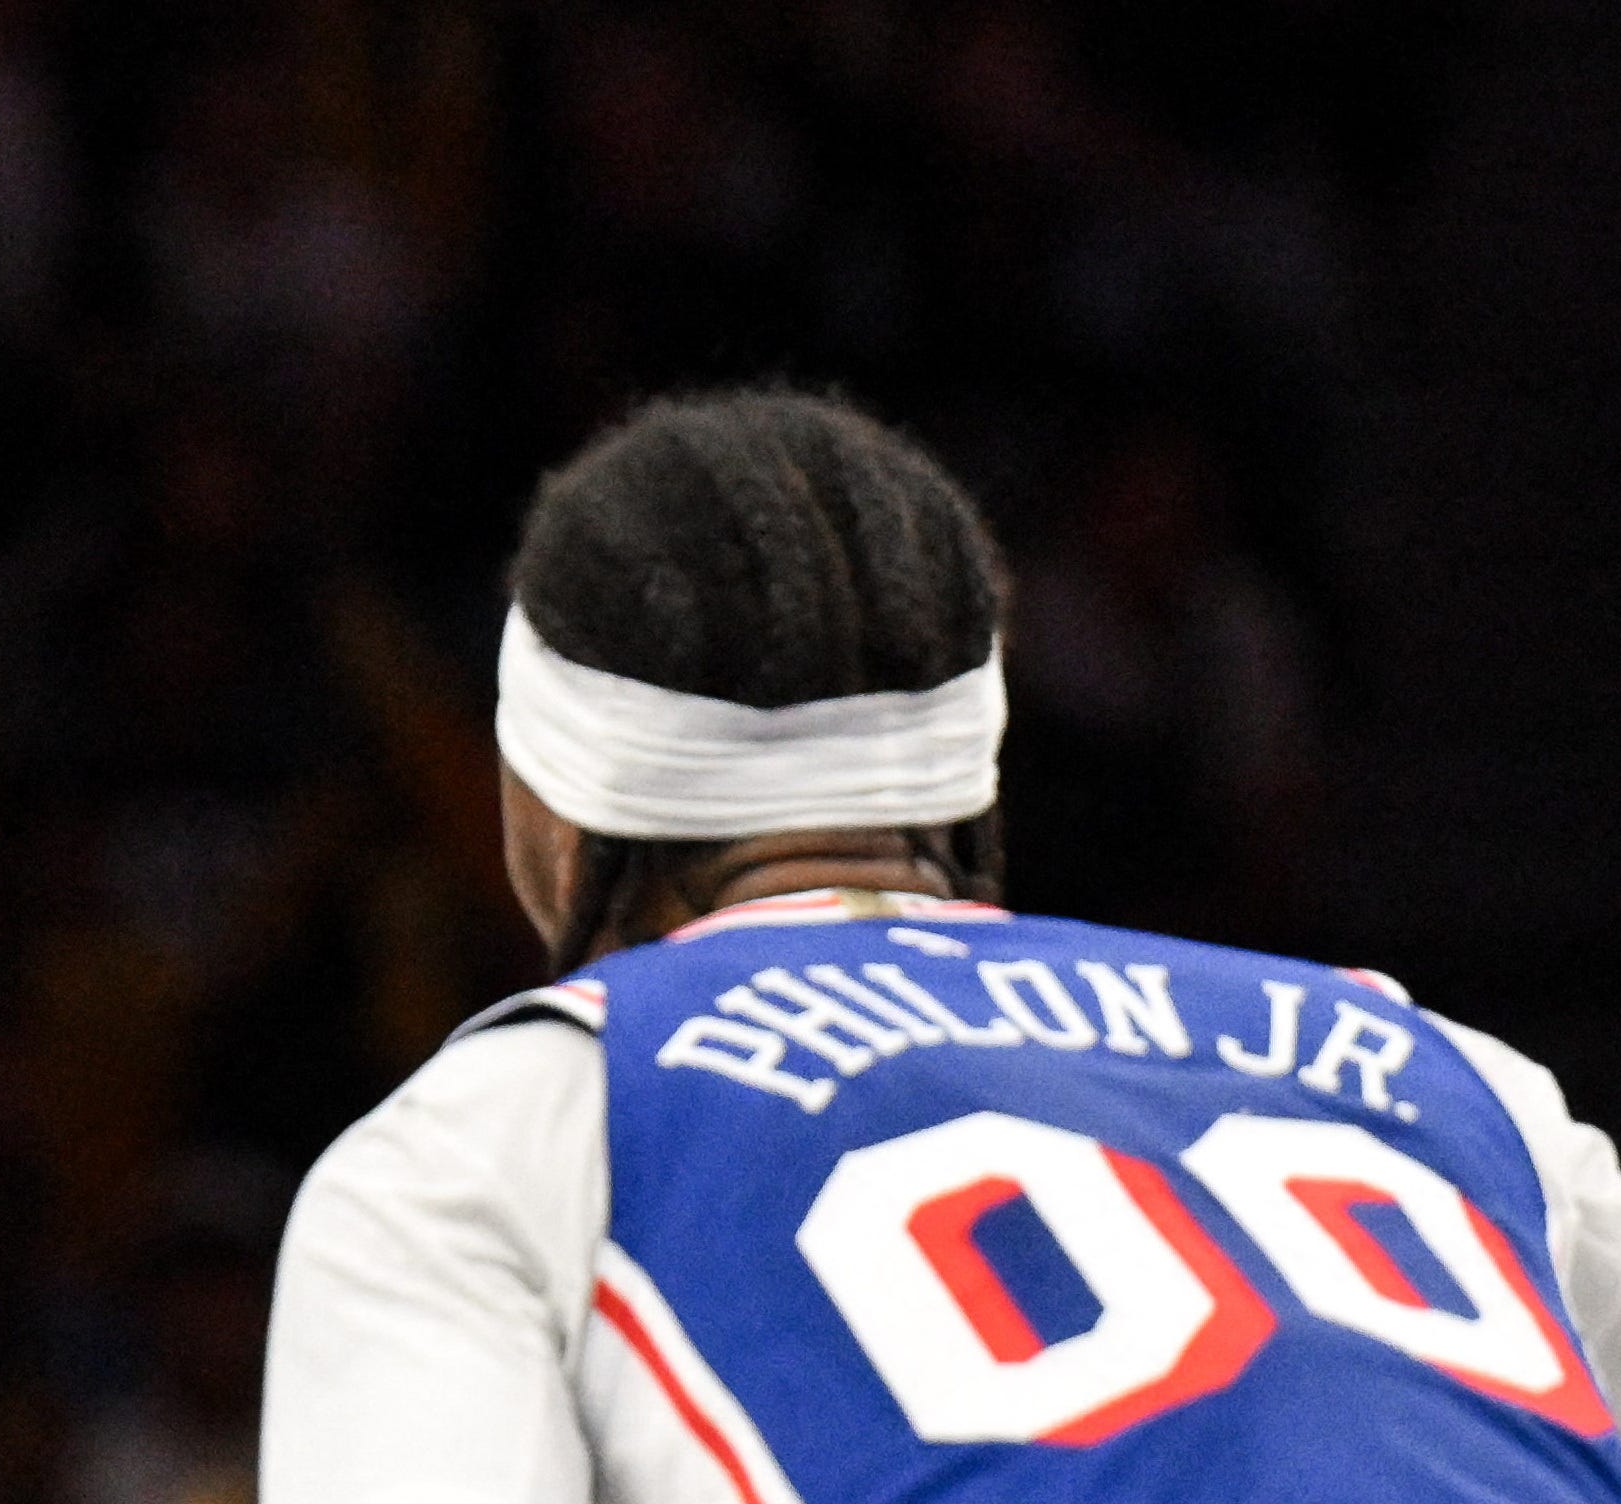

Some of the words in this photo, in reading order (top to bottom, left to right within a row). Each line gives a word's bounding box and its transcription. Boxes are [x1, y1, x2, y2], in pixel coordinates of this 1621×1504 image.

[656, 957, 1193, 1114] PHILON
[1215, 979, 1421, 1124] JR.
[795, 1110, 1617, 1448] 00
